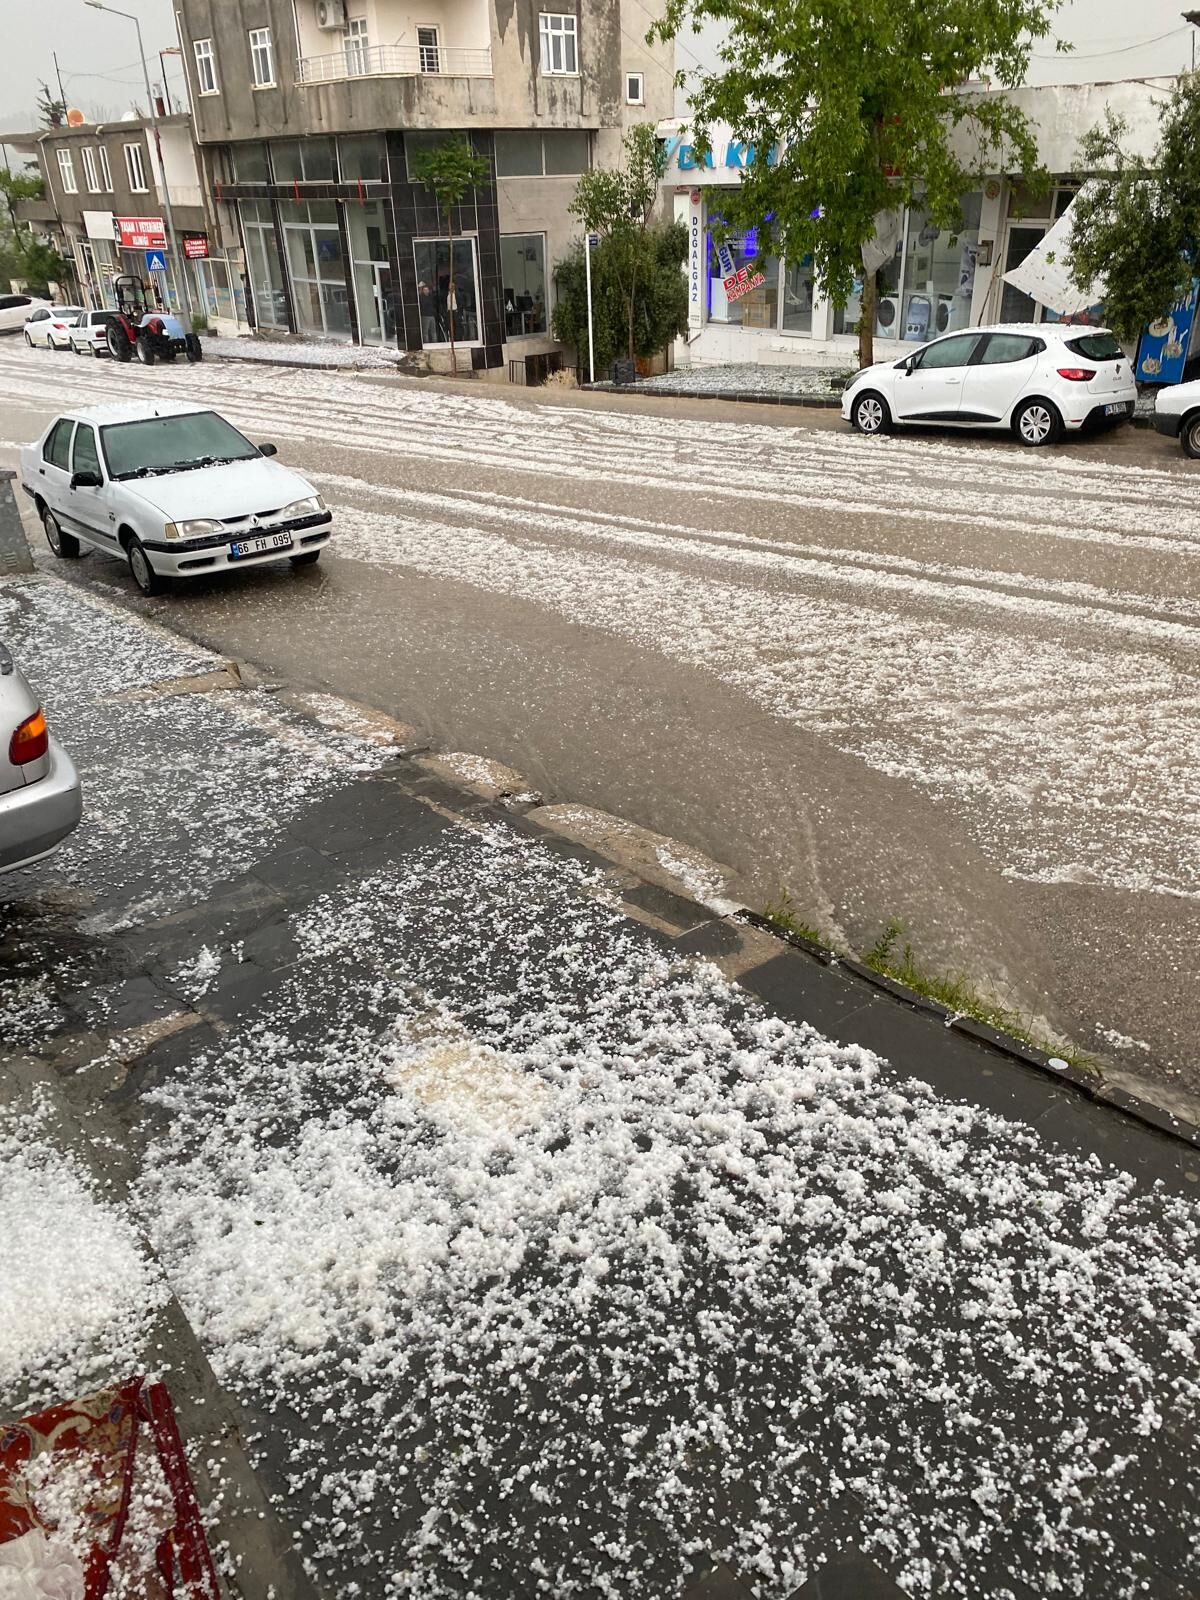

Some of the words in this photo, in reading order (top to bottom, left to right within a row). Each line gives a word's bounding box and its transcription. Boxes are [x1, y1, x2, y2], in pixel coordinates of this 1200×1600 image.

[723, 264, 753, 290] DE
[238, 543, 249, 554] 66
[255, 538, 267, 550] FH
[273, 534, 289, 546] 095
